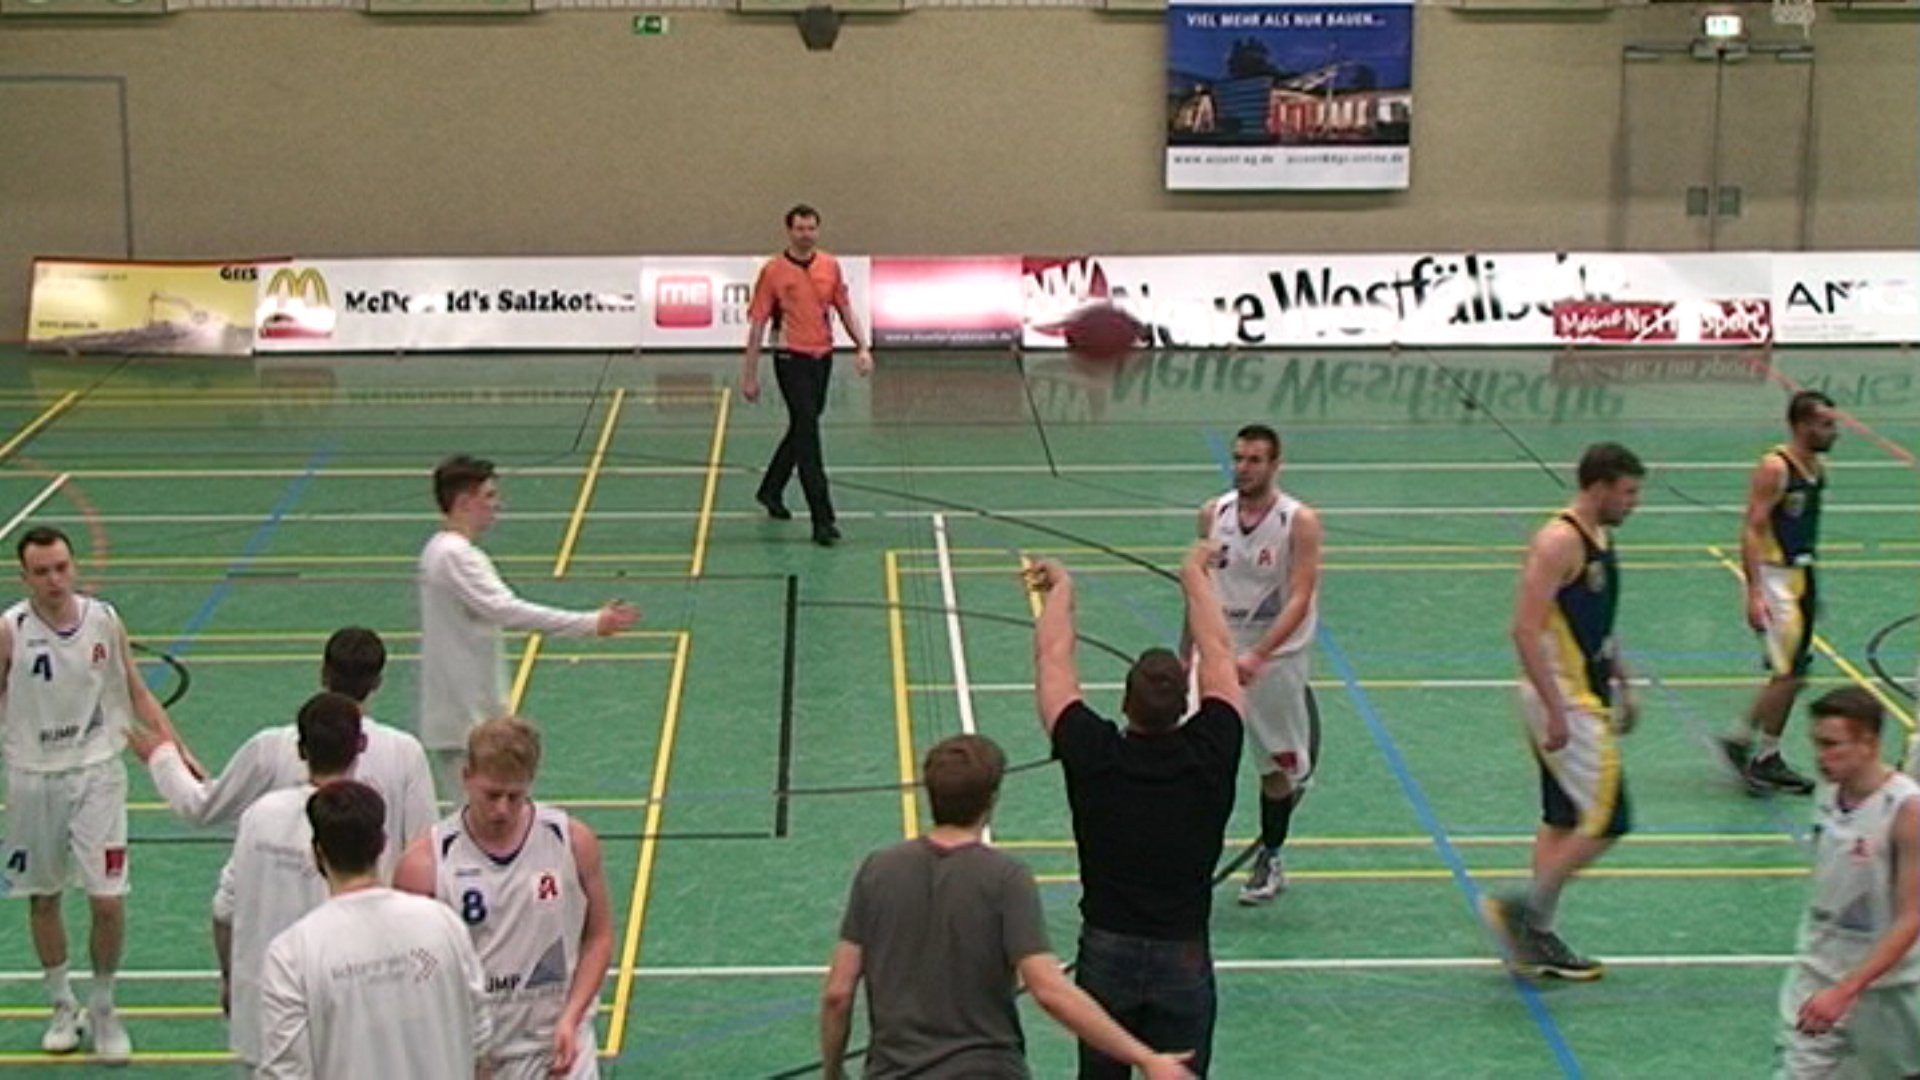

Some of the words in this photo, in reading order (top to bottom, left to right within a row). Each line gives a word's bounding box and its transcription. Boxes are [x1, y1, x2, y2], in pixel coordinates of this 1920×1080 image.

[1187, 13, 1217, 27] VIEL
[1220, 13, 1260, 27] MEHR
[1263, 13, 1290, 27] ALS
[1293, 13, 1322, 27] NUR
[461, 888, 488, 924] 8
